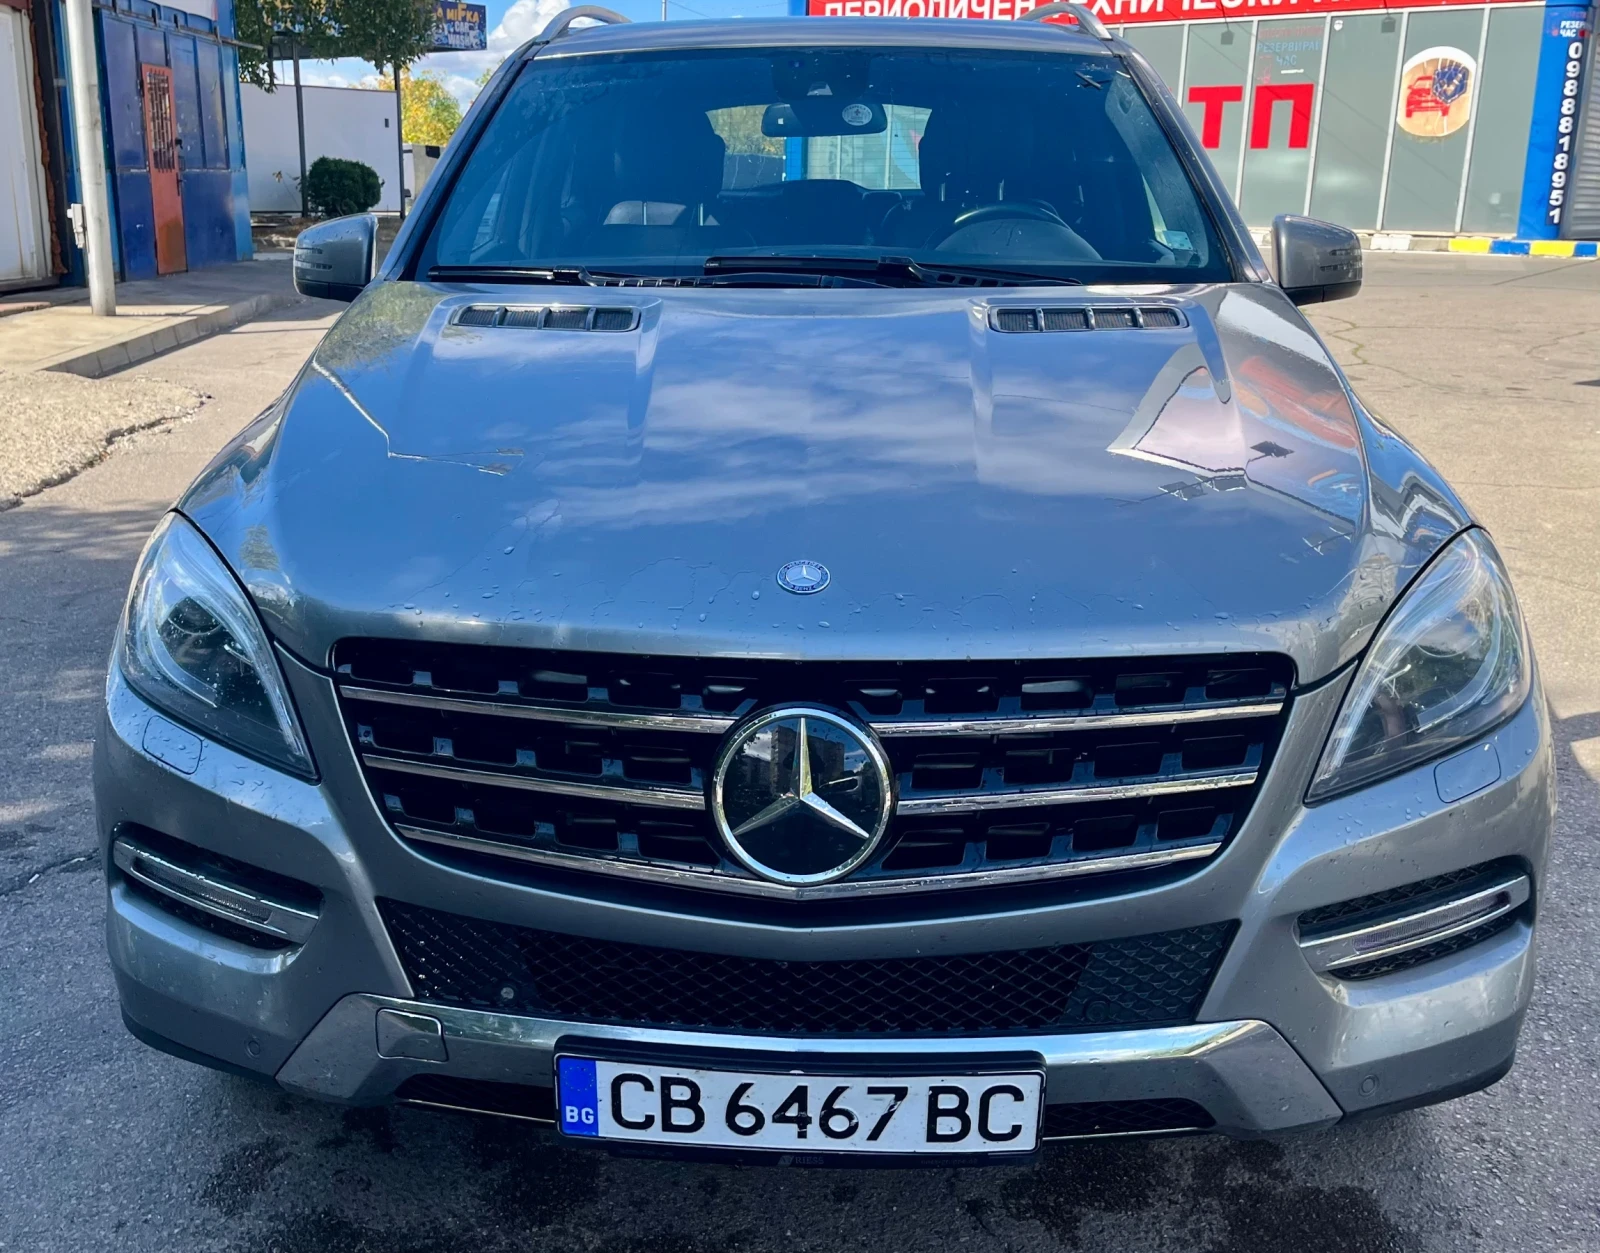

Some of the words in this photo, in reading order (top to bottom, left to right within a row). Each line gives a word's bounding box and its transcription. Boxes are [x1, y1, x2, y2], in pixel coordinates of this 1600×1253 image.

[1549, 42, 1583, 224] 0988818951
[565, 1105, 595, 1124] BG
[611, 1073, 706, 1134] CB
[725, 1082, 909, 1142] 6467
[926, 1084, 1025, 1143] BC
